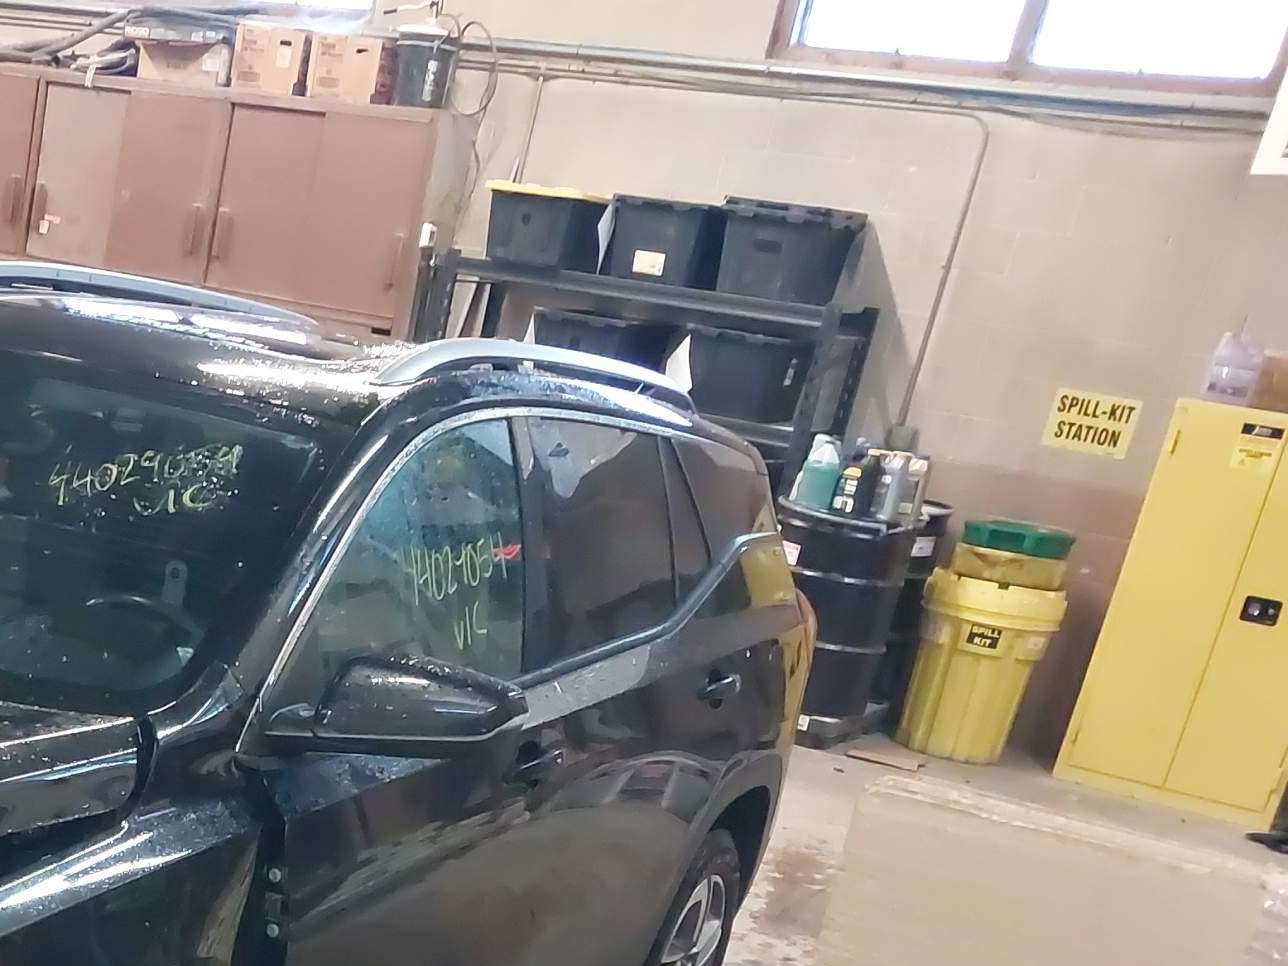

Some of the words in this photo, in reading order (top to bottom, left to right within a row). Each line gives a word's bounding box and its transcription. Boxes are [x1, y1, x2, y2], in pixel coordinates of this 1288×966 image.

[1056, 394, 1136, 424] SPILL-KIT
[1054, 420, 1122, 449] STATION
[972, 624, 1001, 639] SPILL
[973, 635, 994, 648] KIT
